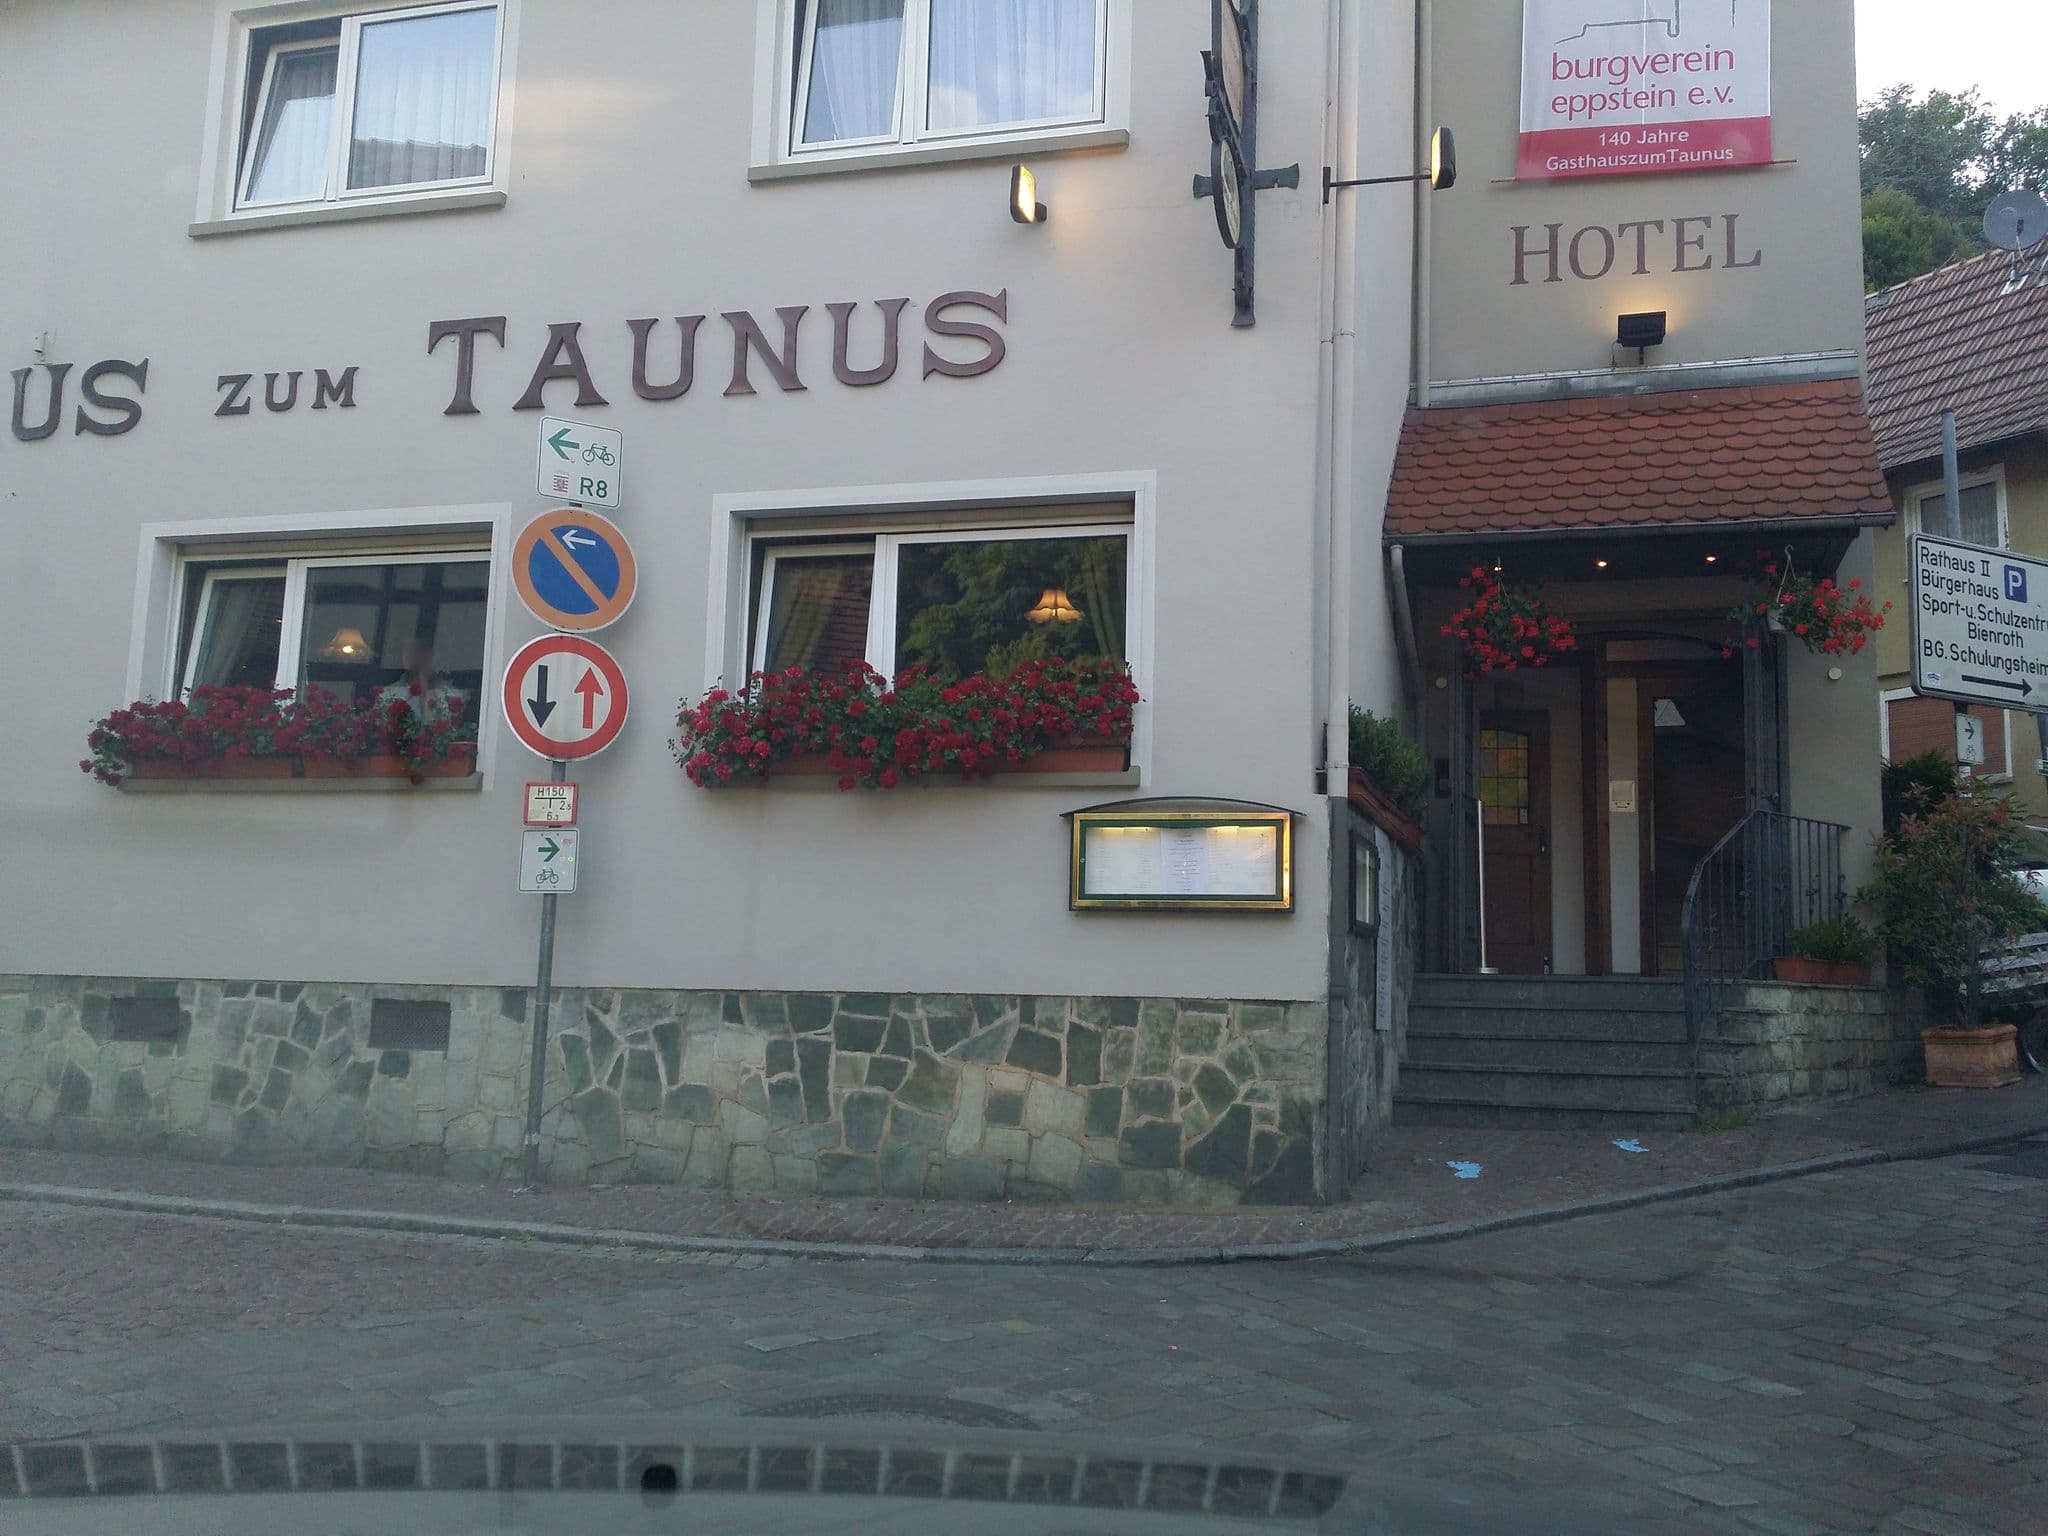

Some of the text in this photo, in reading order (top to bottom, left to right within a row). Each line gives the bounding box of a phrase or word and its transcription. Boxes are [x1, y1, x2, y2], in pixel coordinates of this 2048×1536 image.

[1552, 44, 1735, 86] burgverein
[1551, 84, 1735, 121] eppstein e.v.
[1599, 129, 1690, 147] 140 Jahre
[1509, 214, 1762, 286] HOTEL
[10, 288, 1008, 441] US ZUM TAUNUS
[580, 476, 608, 498] R8
[1920, 546, 1992, 578] Rathaus II
[1921, 568, 2000, 601] Bürgerhaus
[1967, 621, 2025, 649] Bienroth
